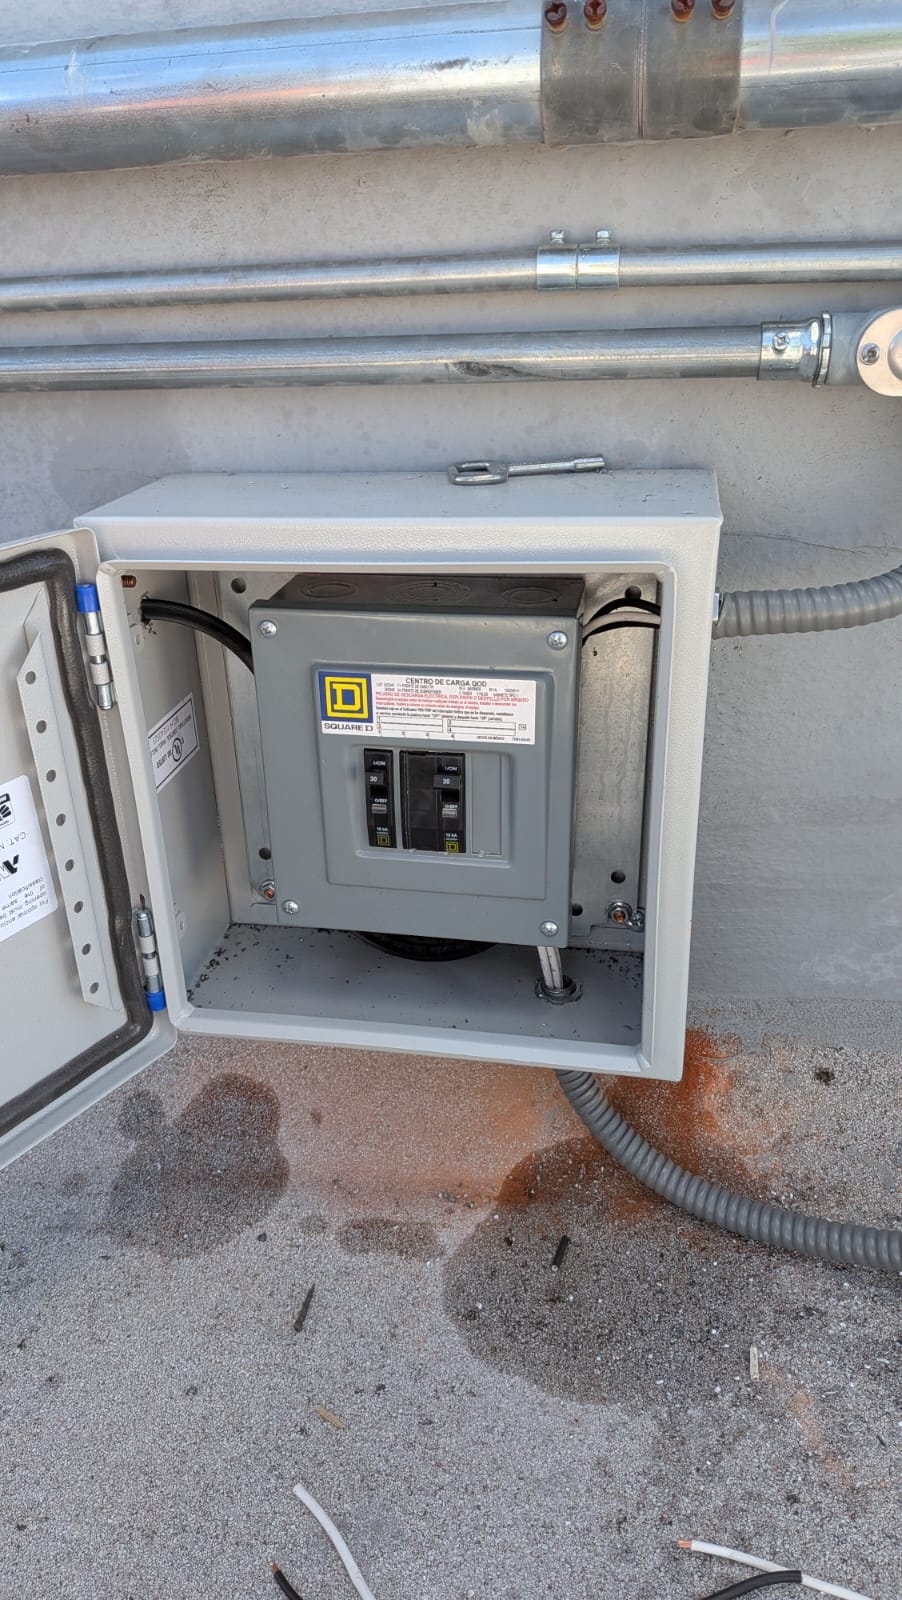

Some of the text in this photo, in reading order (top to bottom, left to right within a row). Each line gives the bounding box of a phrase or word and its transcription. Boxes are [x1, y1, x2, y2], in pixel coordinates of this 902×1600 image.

[324, 722, 363, 731] SQUARE
[6, 832, 26, 846] CAT.
[8, 877, 43, 898] classification
